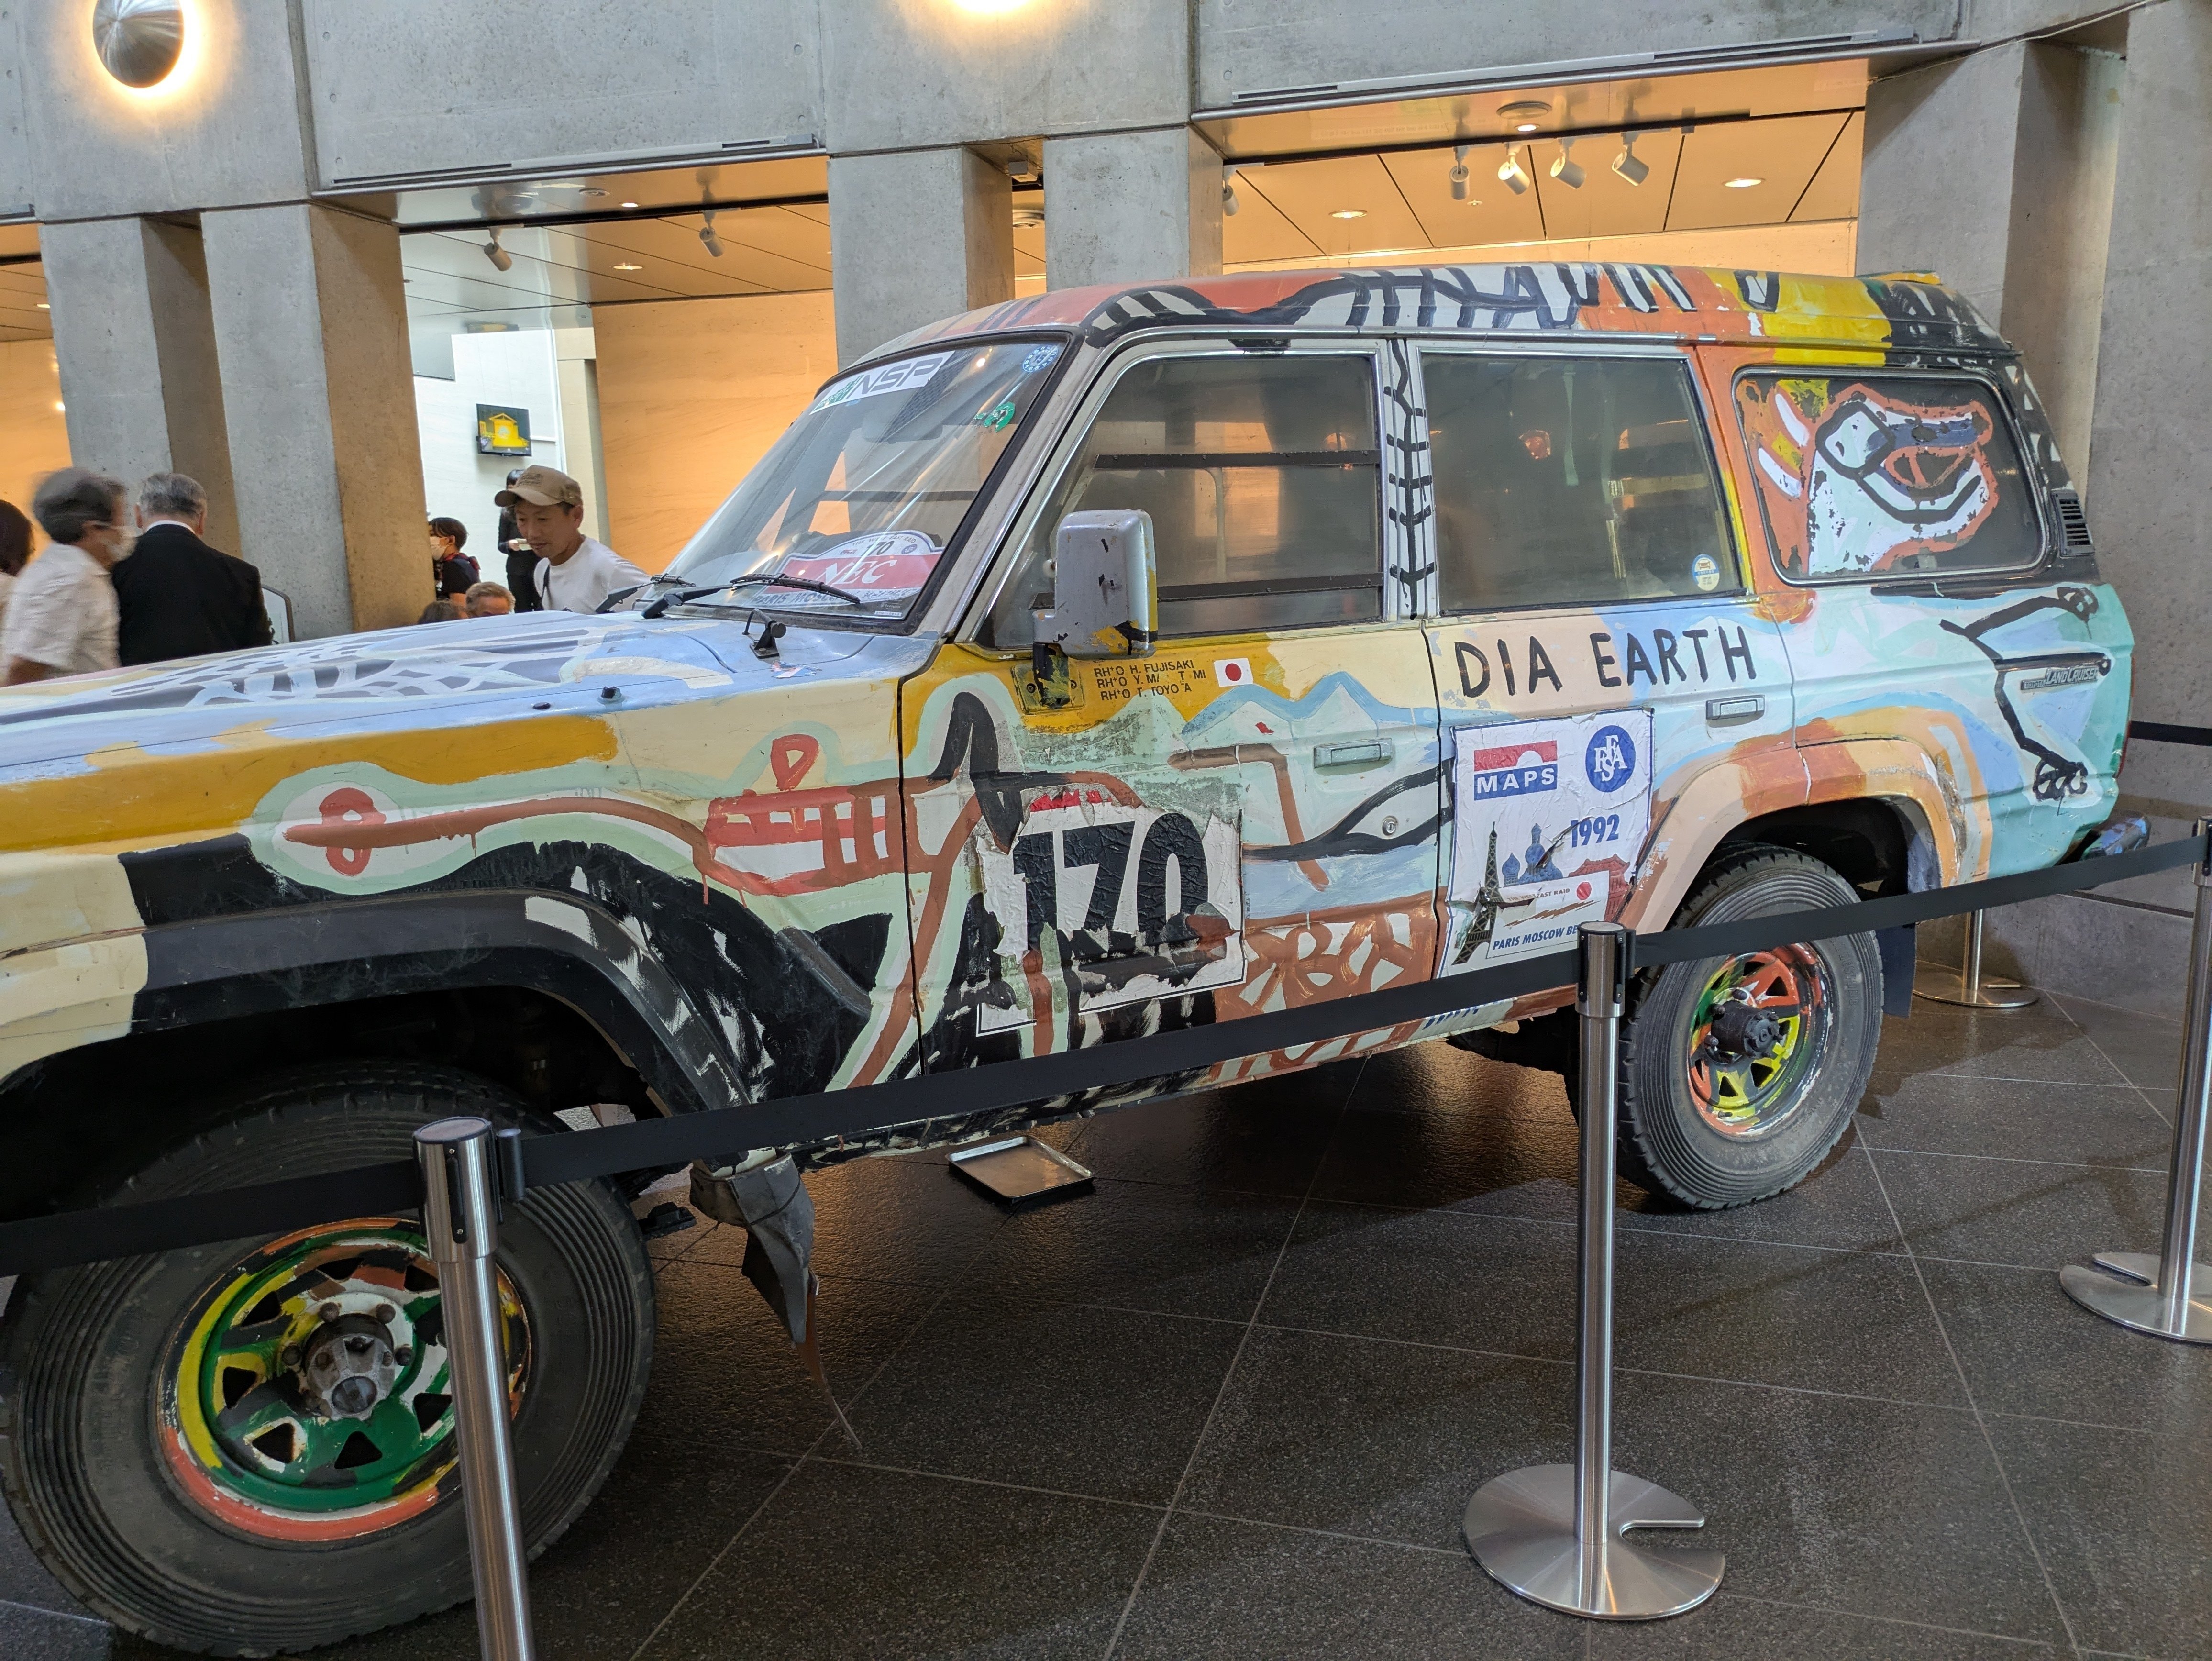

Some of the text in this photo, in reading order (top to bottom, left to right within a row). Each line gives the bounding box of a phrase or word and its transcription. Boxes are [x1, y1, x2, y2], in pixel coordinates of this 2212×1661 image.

[846, 357, 943, 399] NSP
[815, 559, 898, 585] NEC
[1129, 664, 1142, 674] H.
[1144, 659, 1194, 672] FUJISAKI
[1454, 626, 1757, 698] DIA EARTH
[1133, 675, 1144, 685] Y.
[1477, 768, 1555, 794] MAPS
[1570, 814, 1620, 848] 1992
[1013, 812, 1209, 957] 170
[1493, 936, 1520, 950] PARIS
[1522, 927, 1565, 944] MOSCOW
